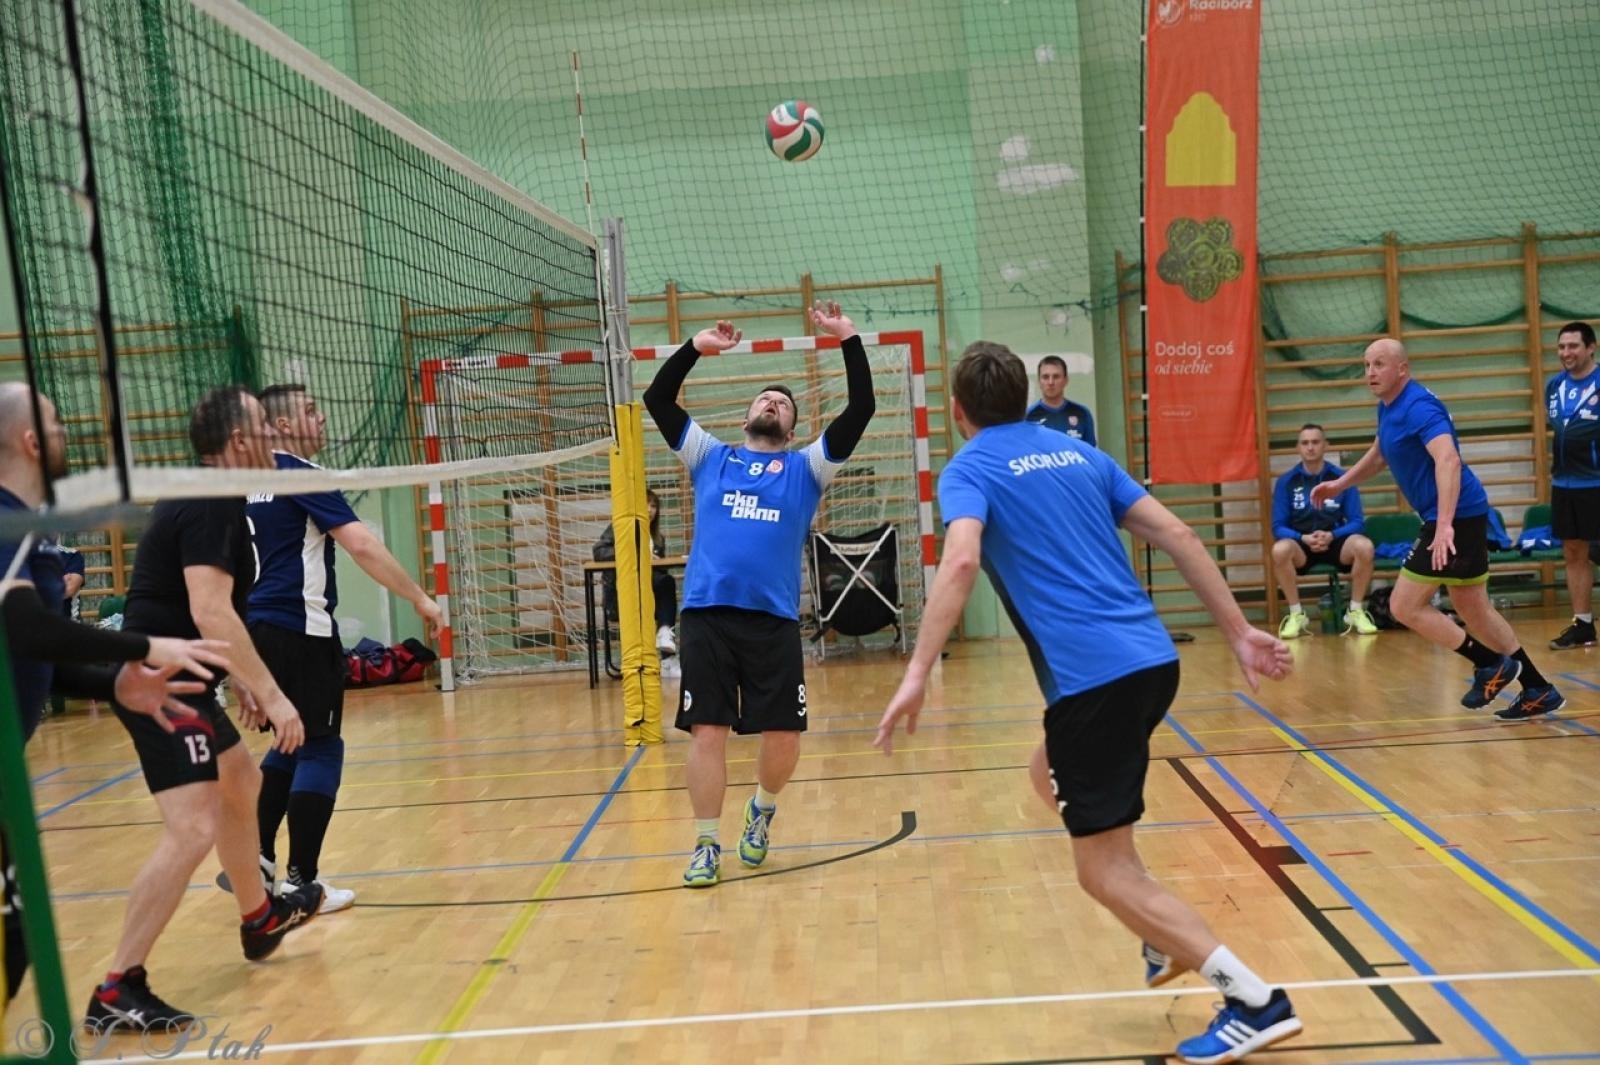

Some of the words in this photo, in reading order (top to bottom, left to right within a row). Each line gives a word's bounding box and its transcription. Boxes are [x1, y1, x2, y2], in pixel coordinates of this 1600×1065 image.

[1155, 341, 1202, 360] Dodaj
[1206, 341, 1234, 356] coś
[1155, 360, 1171, 374] od
[1173, 360, 1213, 375] siebie
[1568, 387, 1578, 400] 6
[748, 461, 764, 476] 8
[1008, 450, 1089, 476] SKORUPA
[797, 683, 806, 704] 8
[184, 734, 211, 764] 13
